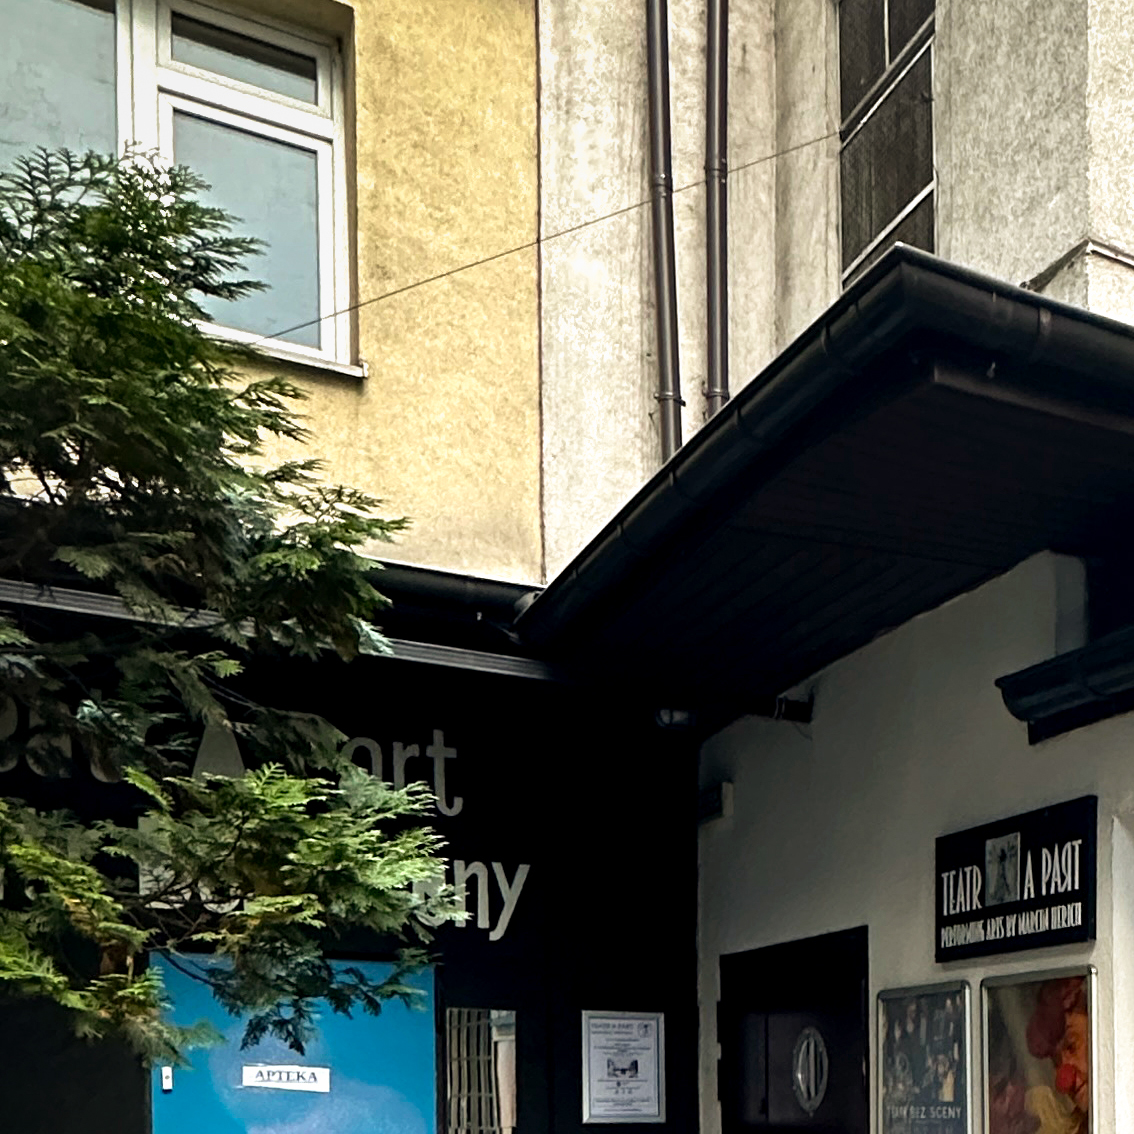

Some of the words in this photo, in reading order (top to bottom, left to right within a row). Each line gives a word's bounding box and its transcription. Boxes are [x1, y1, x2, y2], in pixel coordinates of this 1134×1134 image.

[941, 865, 983, 916] TEATR
[1023, 850, 1036, 900] A
[986, 915, 1005, 941] ARTS
[1006, 913, 1017, 938] BY
[1018, 907, 1049, 936] MARCIN
[255, 1070, 318, 1083] APTEKA
[929, 1106, 962, 1119] SCENY
